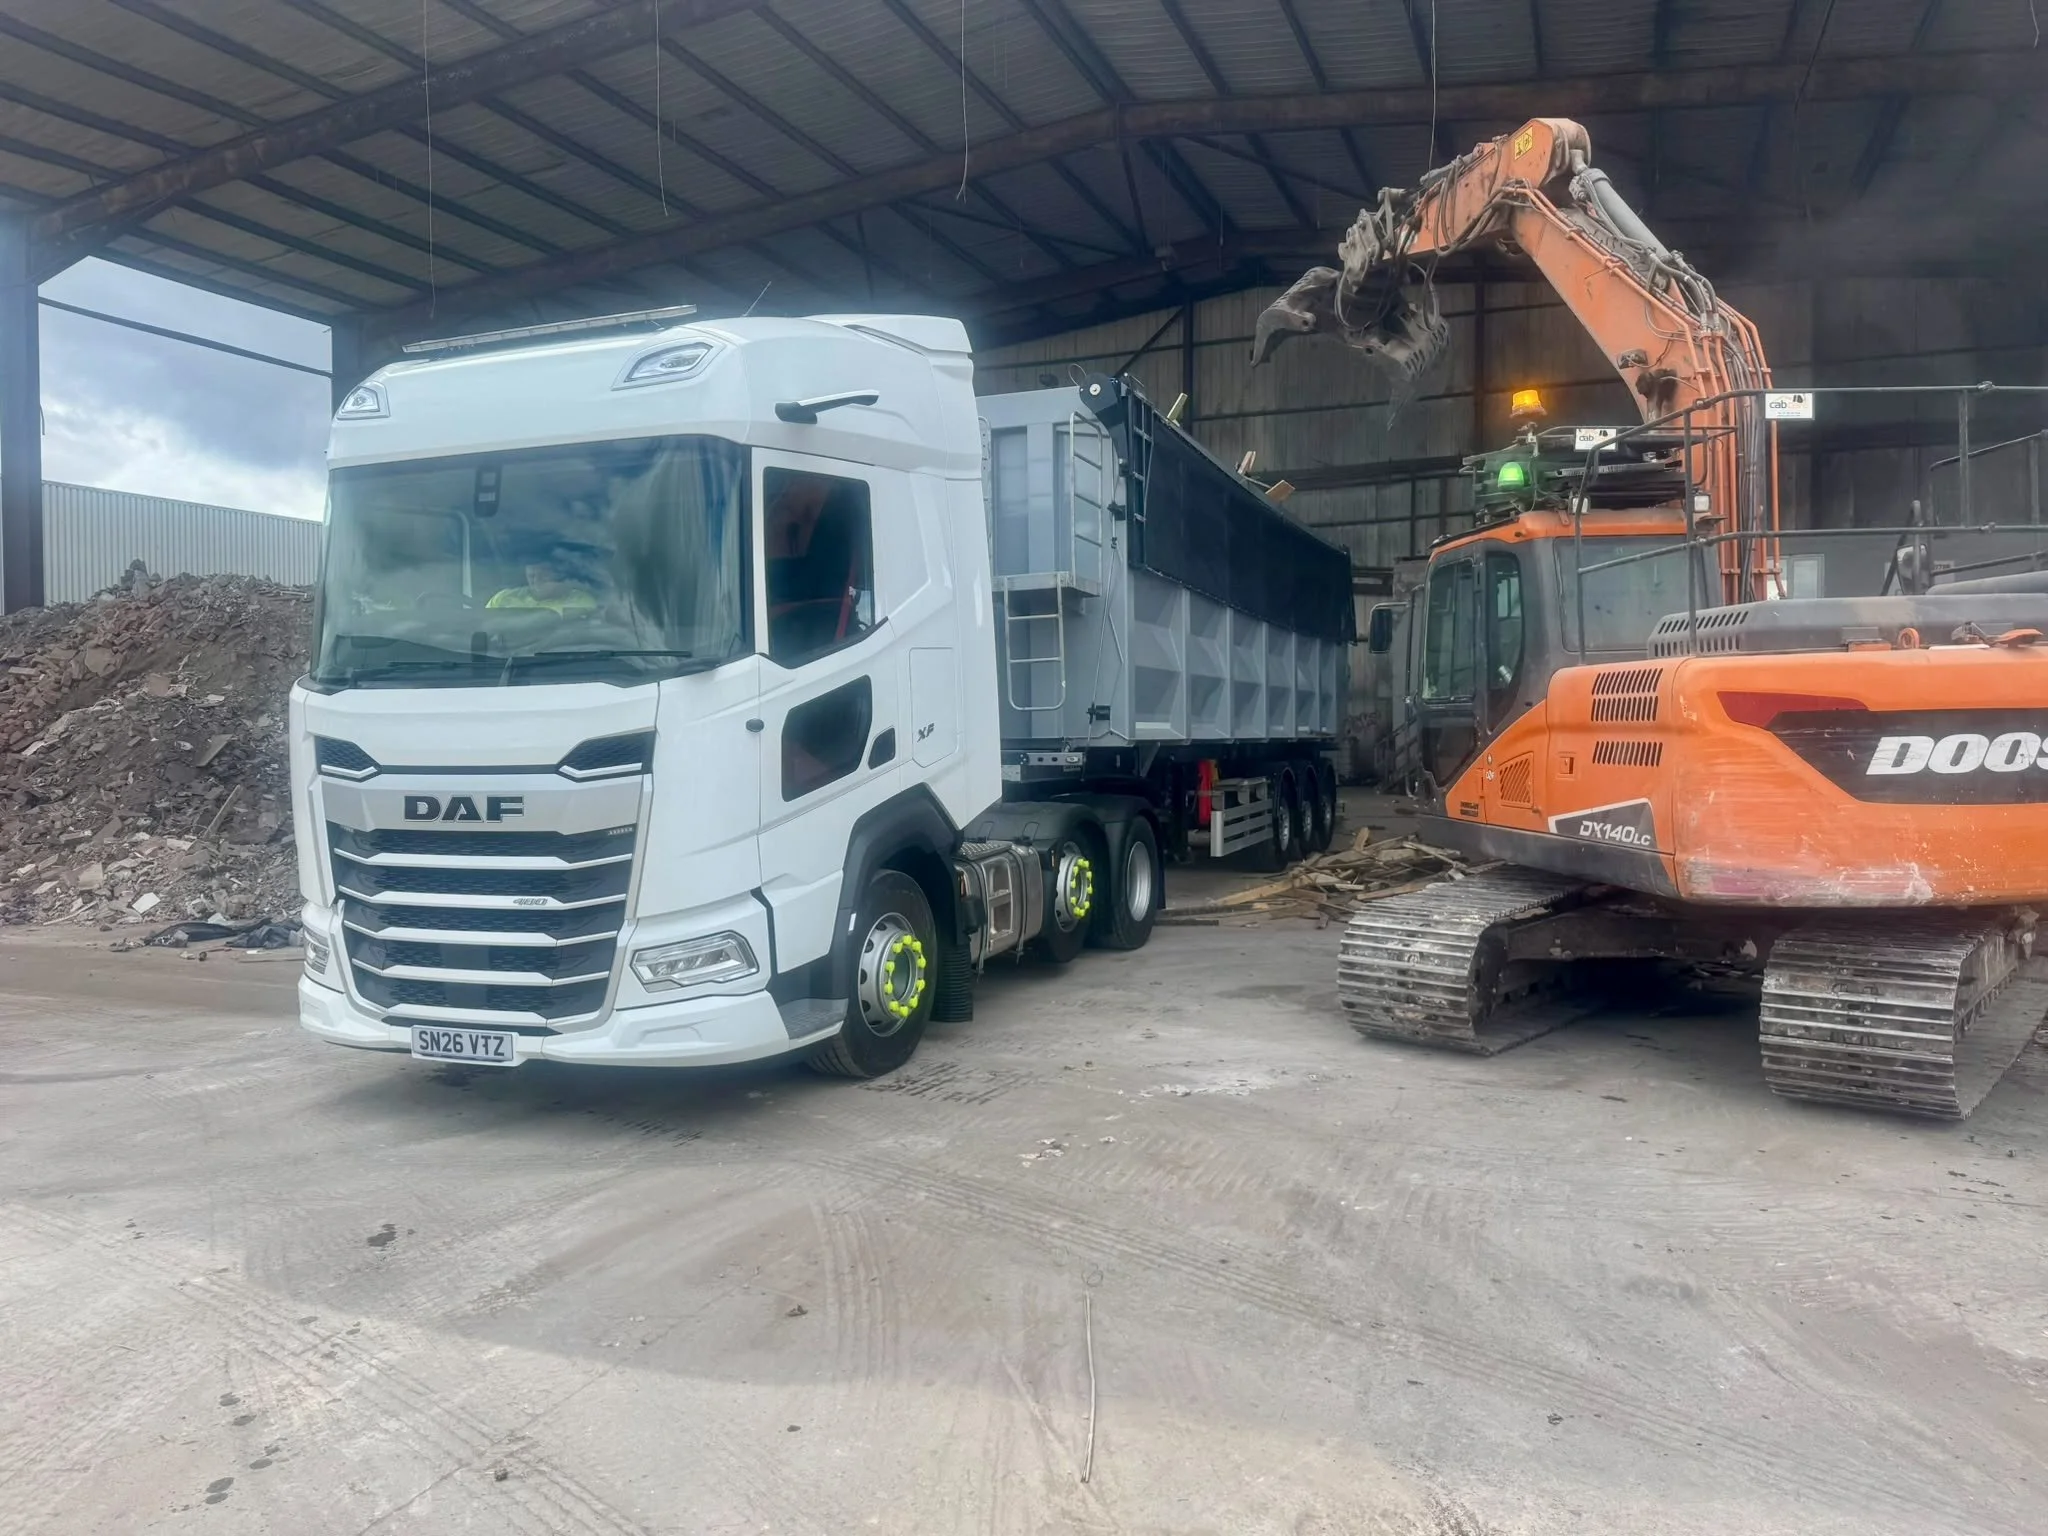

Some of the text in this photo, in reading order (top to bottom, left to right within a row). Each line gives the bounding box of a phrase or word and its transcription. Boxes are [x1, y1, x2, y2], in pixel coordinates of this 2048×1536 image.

[916, 722, 935, 743] XF
[1866, 732, 2048, 775] DOO
[403, 795, 525, 824] DAF
[1579, 820, 1651, 846] DX140LC
[418, 1030, 505, 1057] SN26 VTZ
